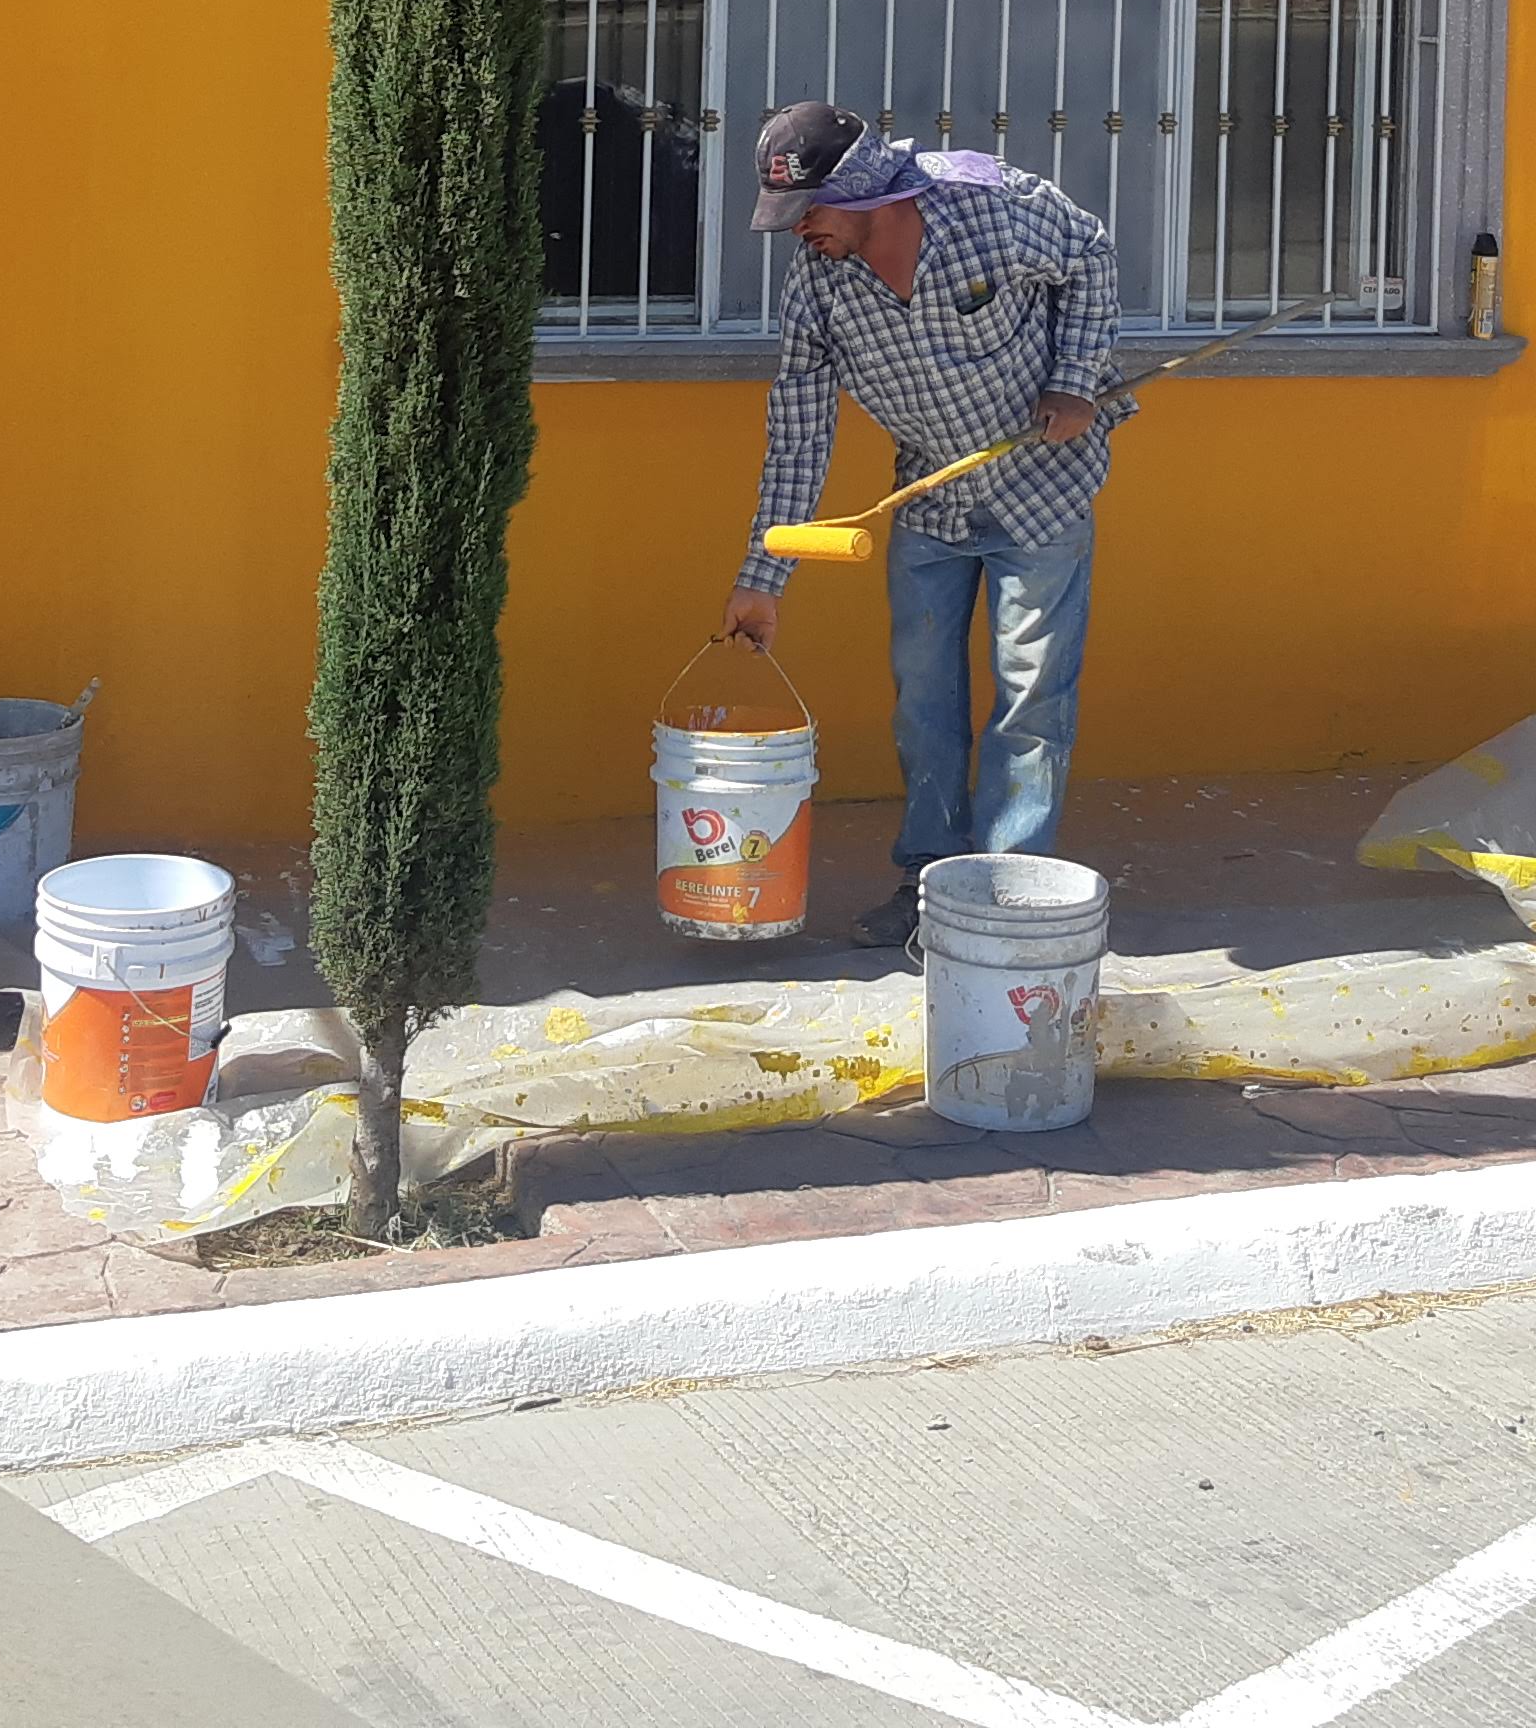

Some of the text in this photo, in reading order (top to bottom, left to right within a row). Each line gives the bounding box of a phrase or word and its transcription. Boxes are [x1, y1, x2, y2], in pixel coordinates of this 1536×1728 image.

[1363, 286, 1400, 295] CEADO
[694, 835, 736, 863] Berel
[675, 878, 742, 898] BERELINTE
[747, 886, 761, 909] 7
